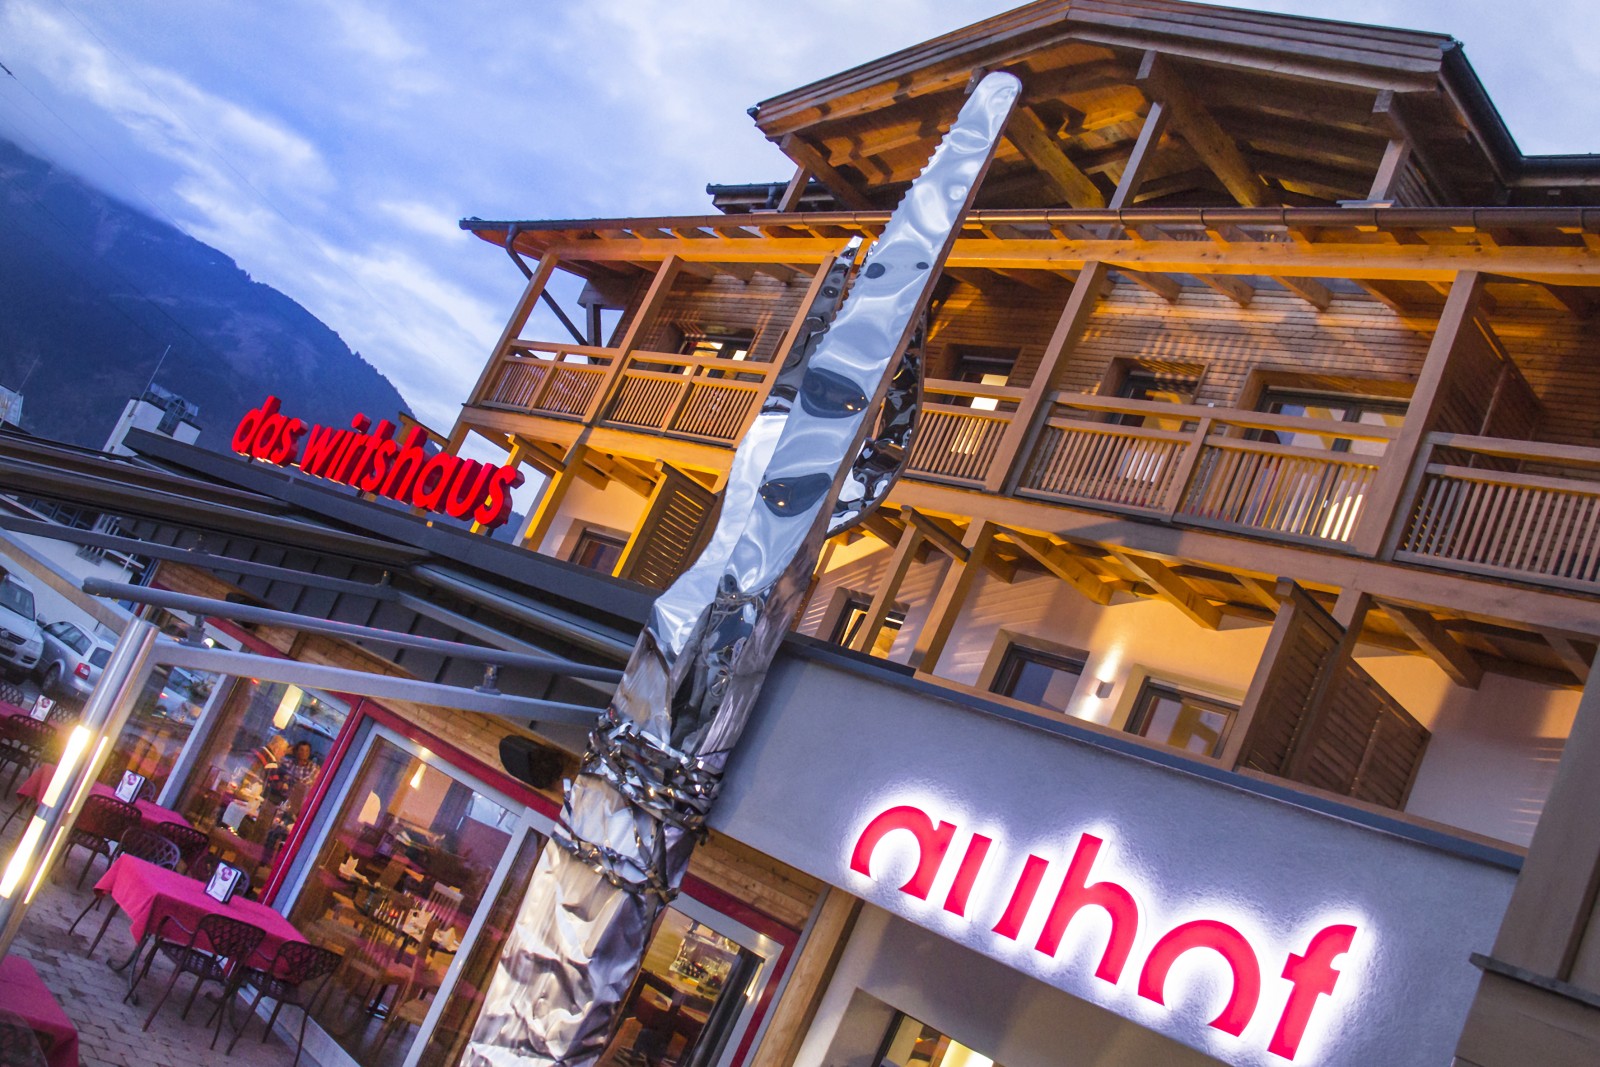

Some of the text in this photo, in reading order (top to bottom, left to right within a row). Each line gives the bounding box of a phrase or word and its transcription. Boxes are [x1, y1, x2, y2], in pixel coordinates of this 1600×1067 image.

[231, 395, 523, 526] das wirtshaus
[850, 806, 1357, 1061] auhof
